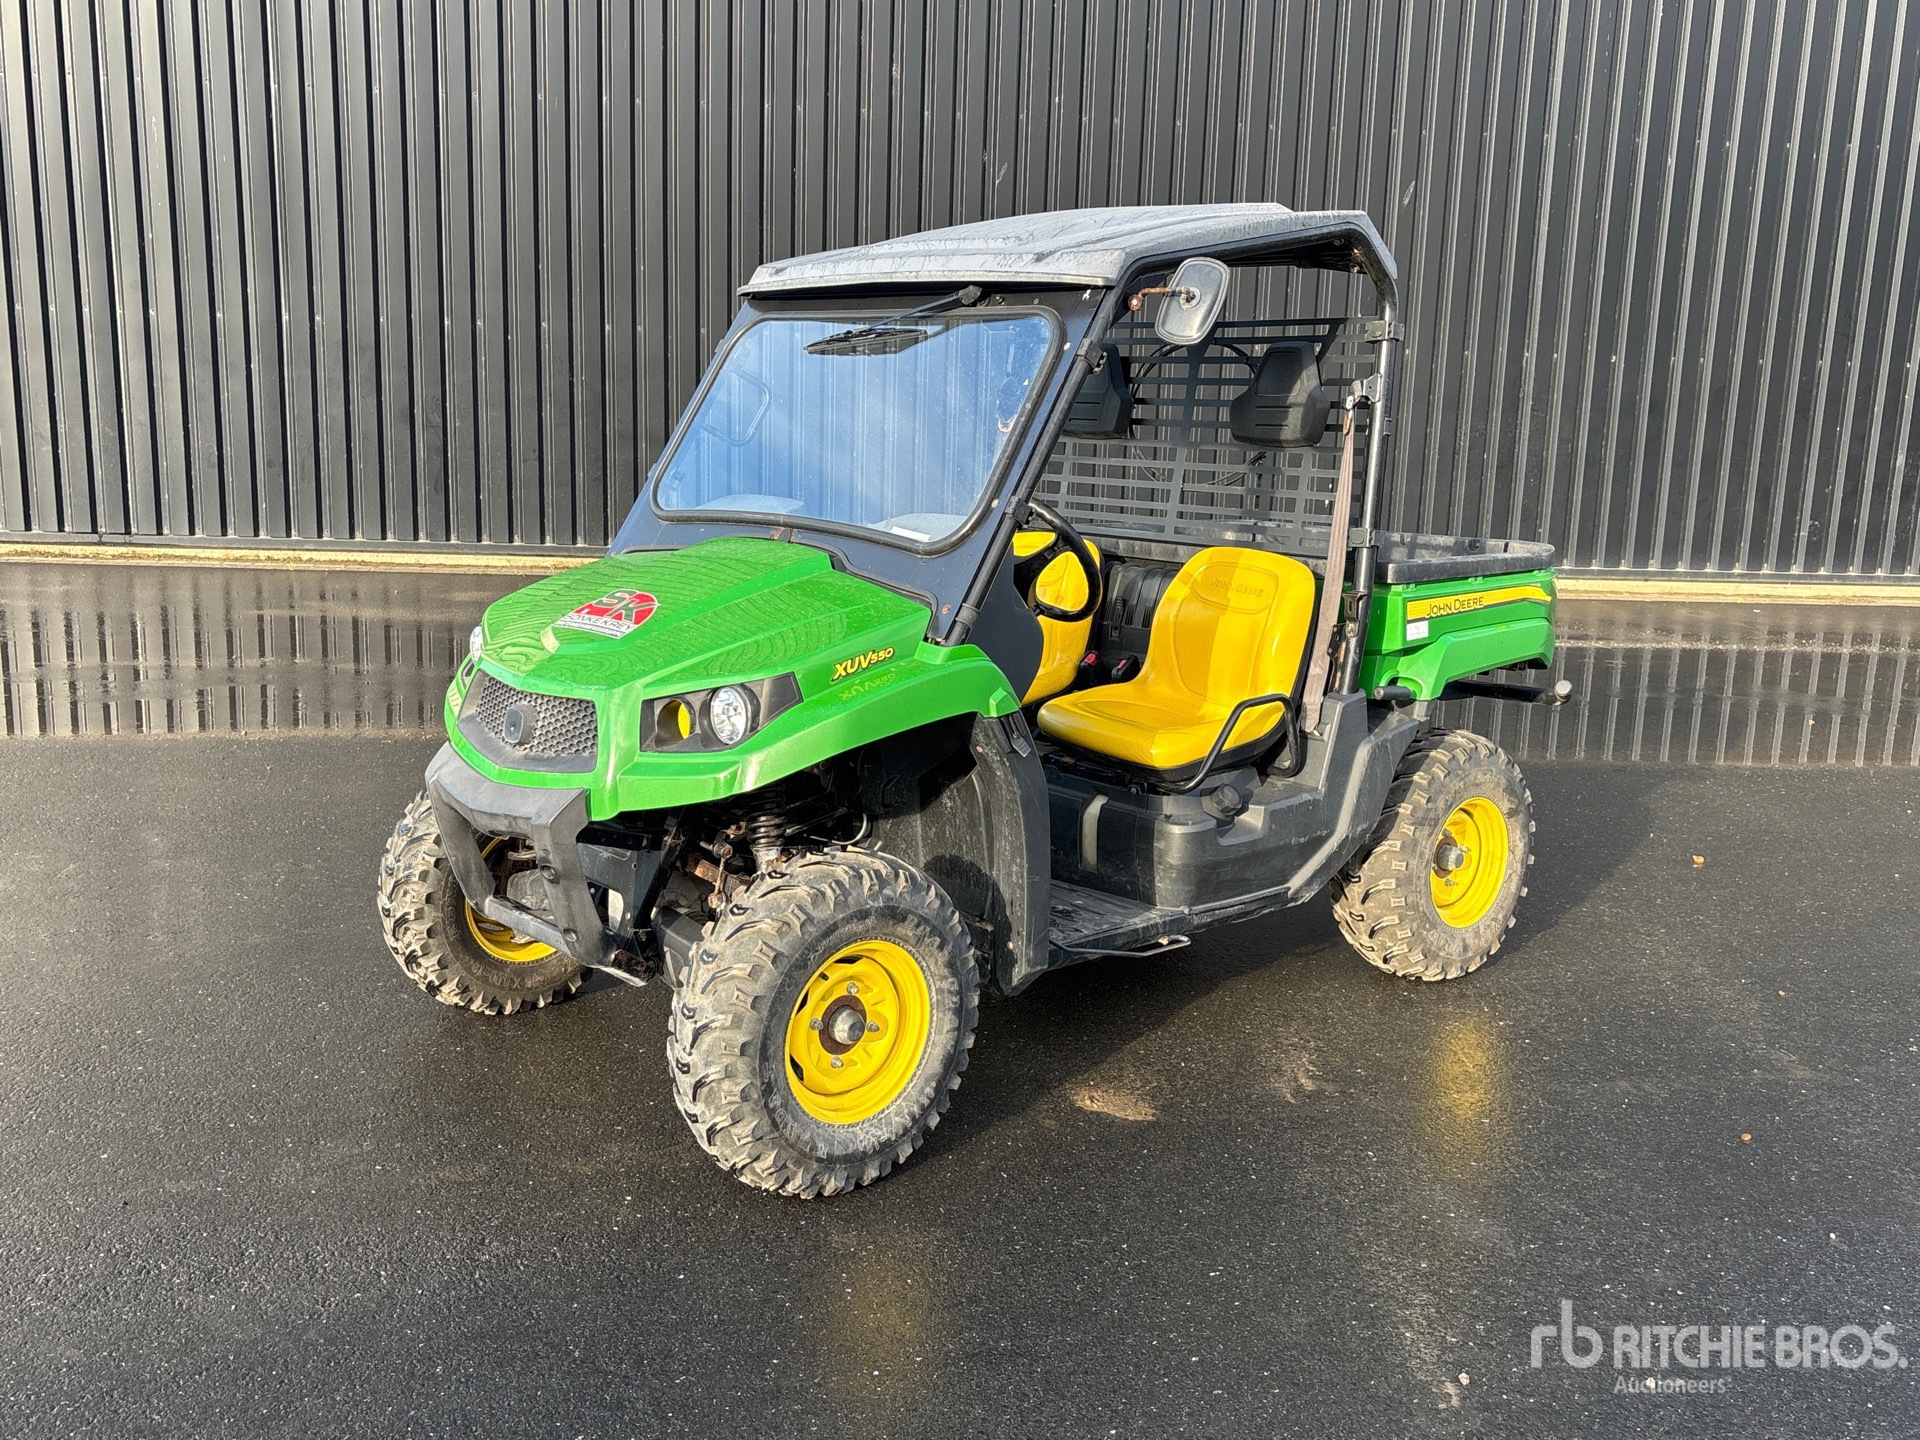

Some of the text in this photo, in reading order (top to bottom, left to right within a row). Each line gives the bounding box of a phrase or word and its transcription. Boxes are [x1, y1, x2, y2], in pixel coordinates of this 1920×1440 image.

[1427, 596, 1484, 617] JOHN DEERE
[831, 647, 895, 682] XUV550
